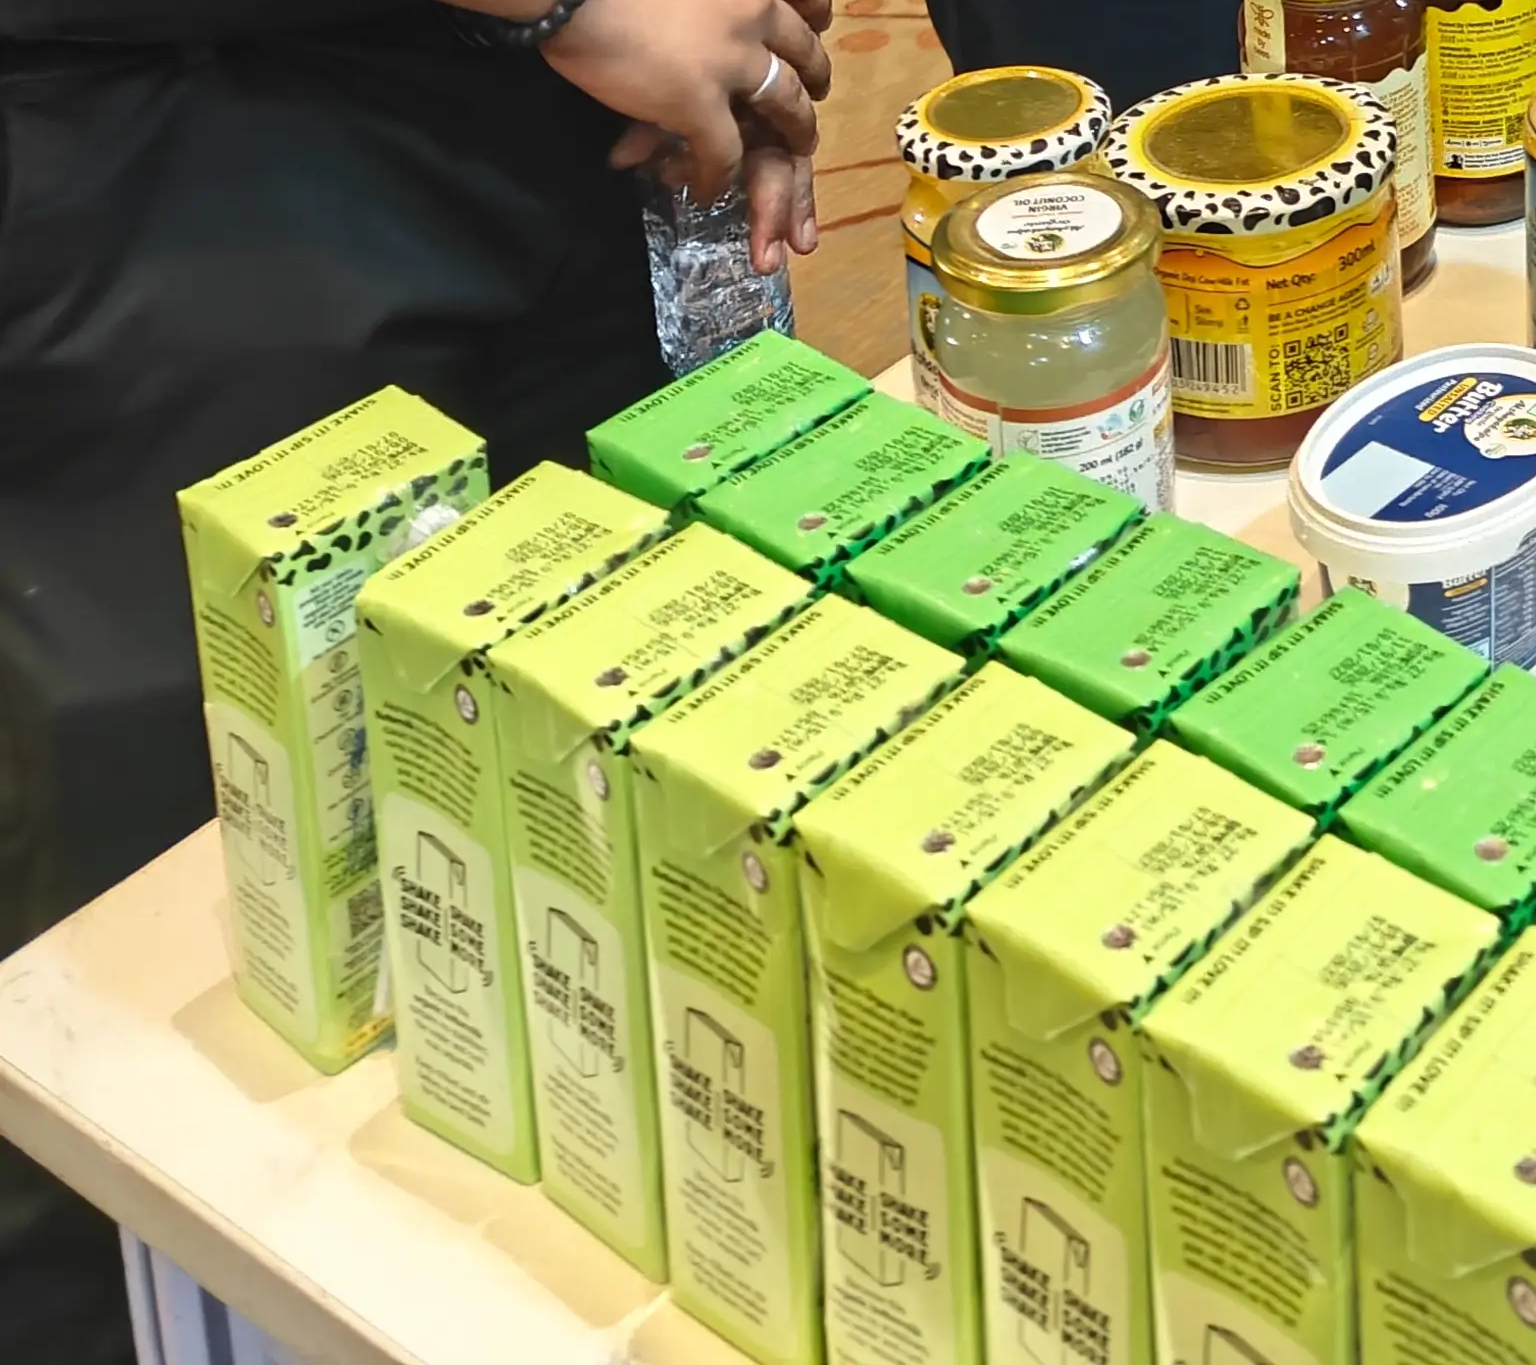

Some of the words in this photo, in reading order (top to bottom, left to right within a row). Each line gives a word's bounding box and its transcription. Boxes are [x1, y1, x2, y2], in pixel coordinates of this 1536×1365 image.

[1028, 203, 1068, 213] VIRGIN
[1032, 195, 1085, 206] COCONUT
[1338, 240, 1375, 271] 300ml
[1266, 279, 1288, 290] Net
[1270, 376, 1281, 412] SCAN
[1433, 379, 1503, 434] Butter
[332, 399, 377, 427] SHAKE
[291, 435, 312, 451] SIP
[235, 459, 270, 483] LOVE
[488, 471, 537, 510] SHAKE
[451, 516, 477, 538] SIP
[1114, 523, 1156, 560] SHAKE
[403, 541, 440, 571] LOVE
[1083, 566, 1104, 586] SIP
[1045, 590, 1075, 617] LOVE
[1299, 596, 1343, 637] SHAKE
[1265, 641, 1288, 663] SIP
[1218, 666, 1253, 698] LOVE
